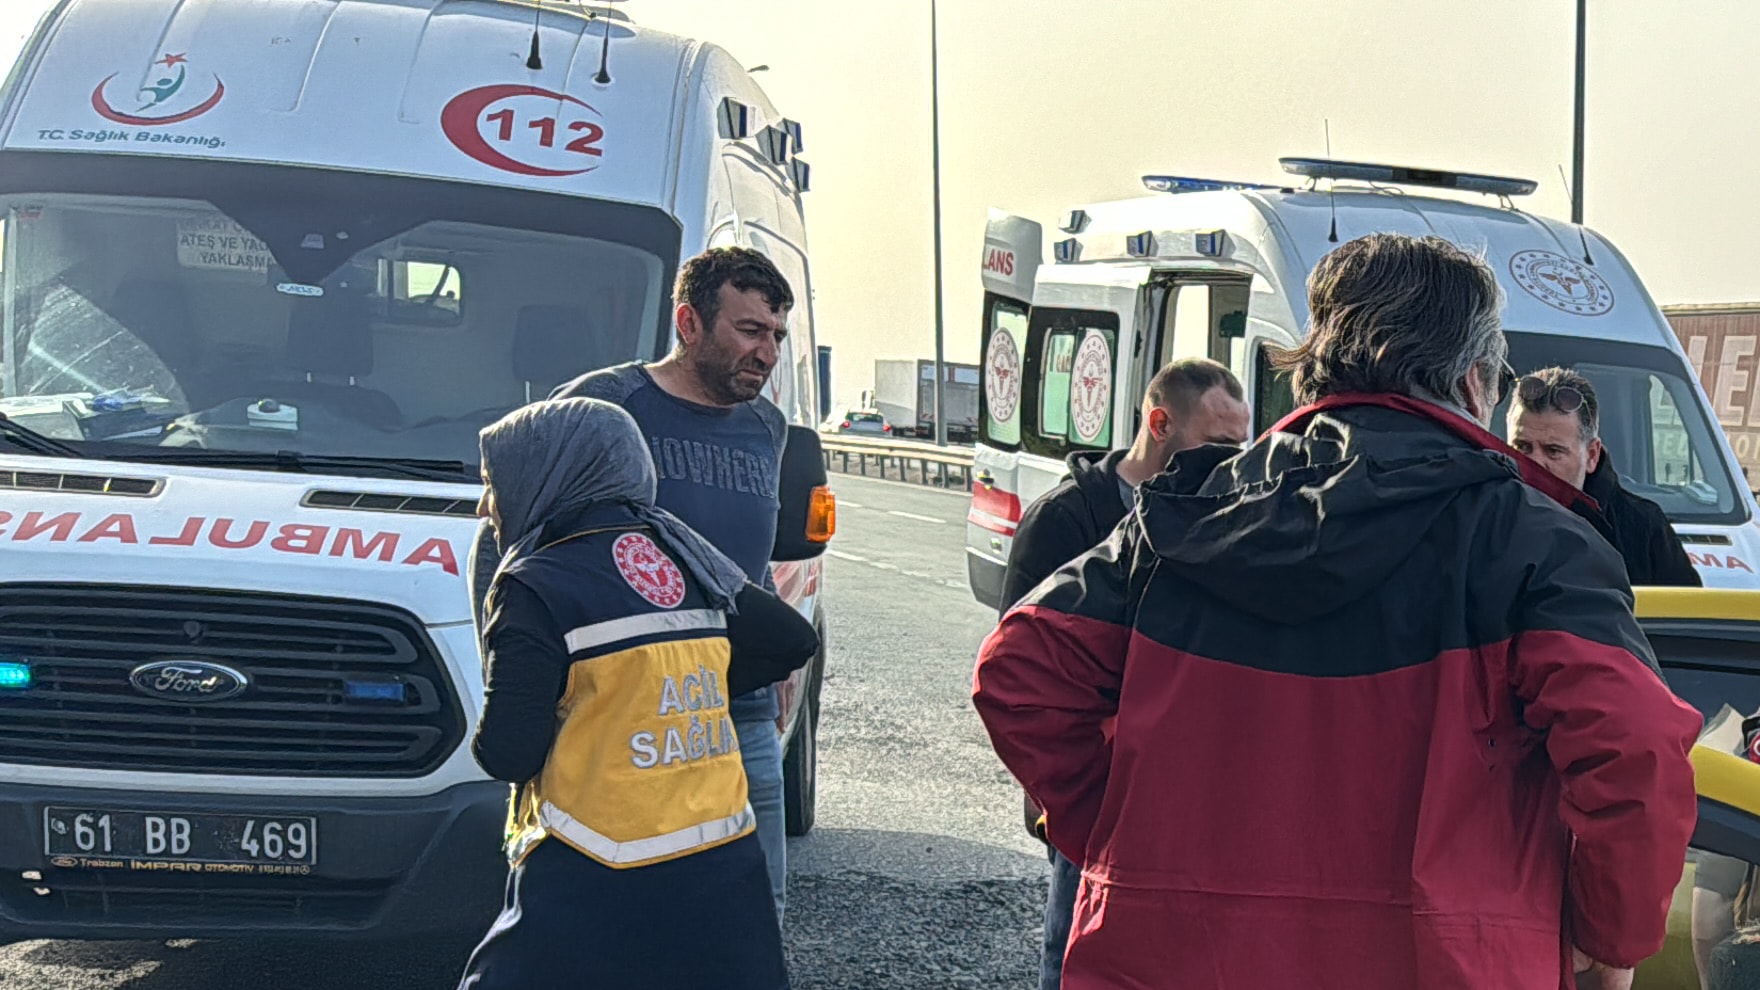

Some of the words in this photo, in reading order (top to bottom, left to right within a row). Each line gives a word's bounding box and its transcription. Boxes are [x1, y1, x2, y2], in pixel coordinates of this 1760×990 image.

[68, 129, 130, 143] Sağlık
[134, 131, 226, 149] Bakanlığı
[486, 108, 604, 157] 112
[155, 667, 218, 692] Ford
[658, 664, 724, 715] ACİL
[74, 814, 113, 851] 61
[145, 816, 191, 855] BB
[240, 819, 307, 859] 469
